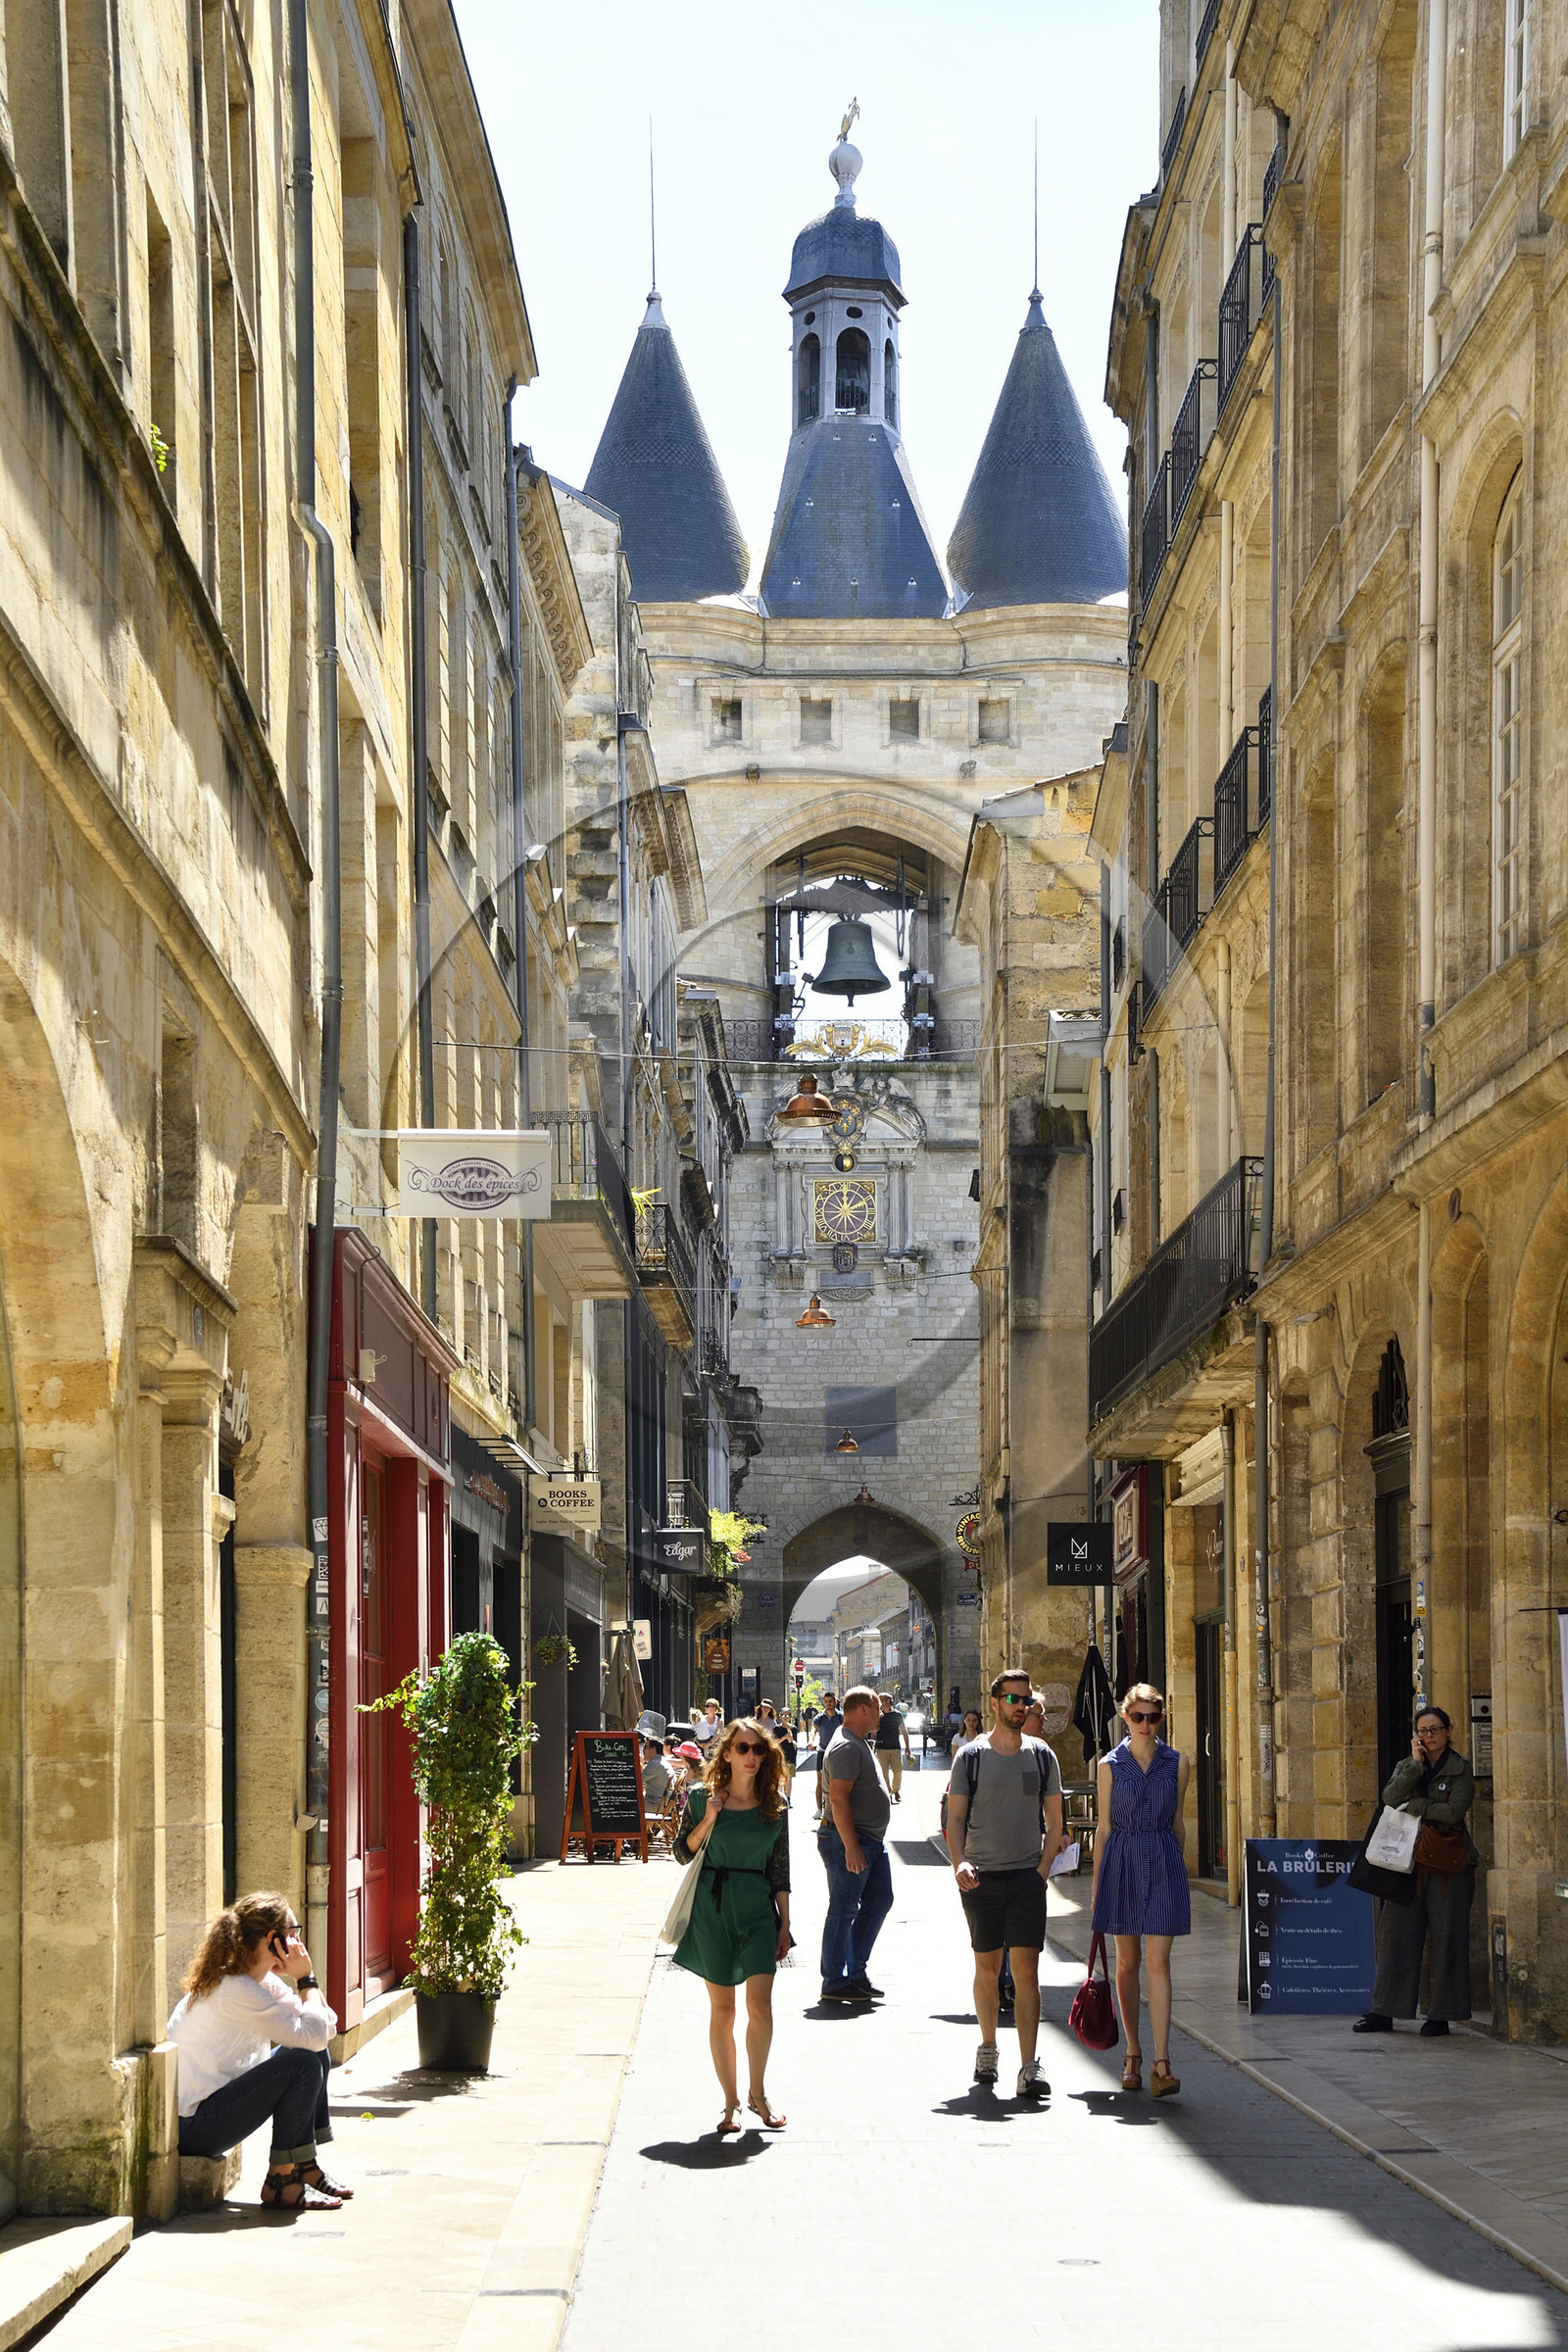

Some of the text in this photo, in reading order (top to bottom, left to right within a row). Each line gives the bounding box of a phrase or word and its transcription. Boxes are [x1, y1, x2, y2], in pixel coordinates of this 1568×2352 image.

[431, 1177, 519, 1193] Dock des épices
[957, 1512, 980, 1533] VINTAG
[663, 1542, 697, 1561] Edgar
[1055, 1563, 1103, 1572] MIEUX
[1256, 1861, 1278, 1872] LA
